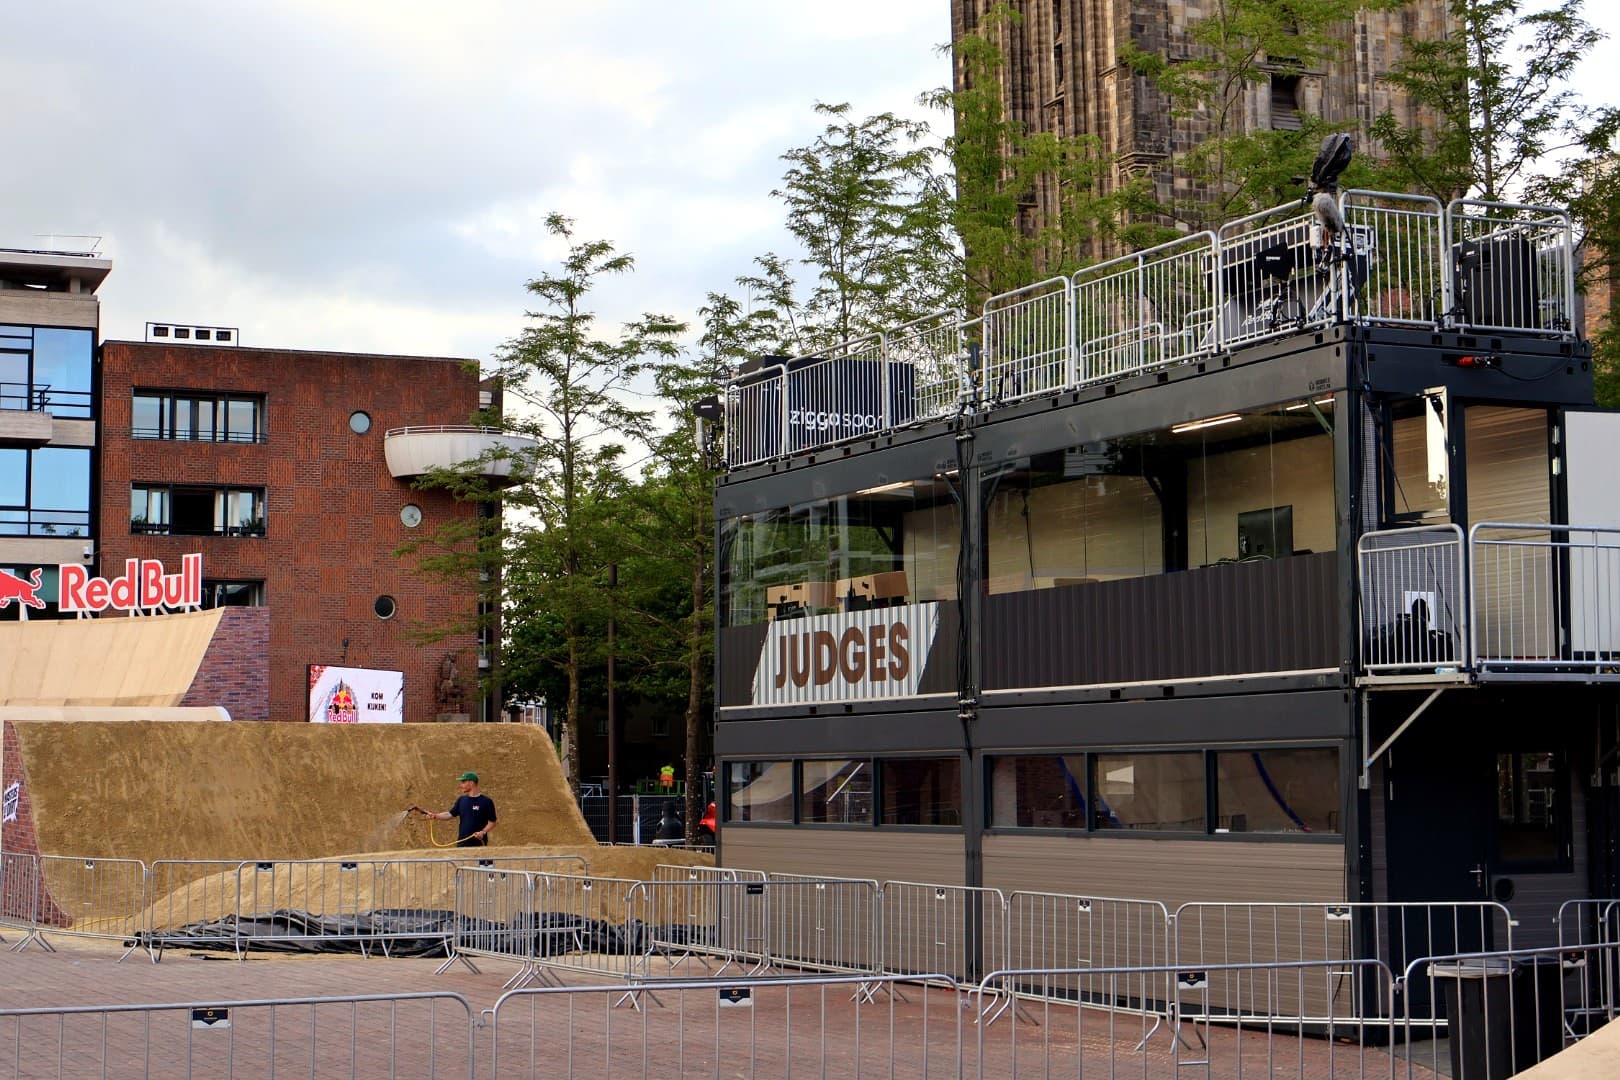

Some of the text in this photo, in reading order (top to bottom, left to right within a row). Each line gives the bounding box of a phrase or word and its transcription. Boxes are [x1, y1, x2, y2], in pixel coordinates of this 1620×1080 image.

[60, 554, 201, 611] Red Bull
[776, 621, 909, 688] JUDGES
[371, 692, 383, 700] KOM
[328, 709, 357, 723] Red Bull
